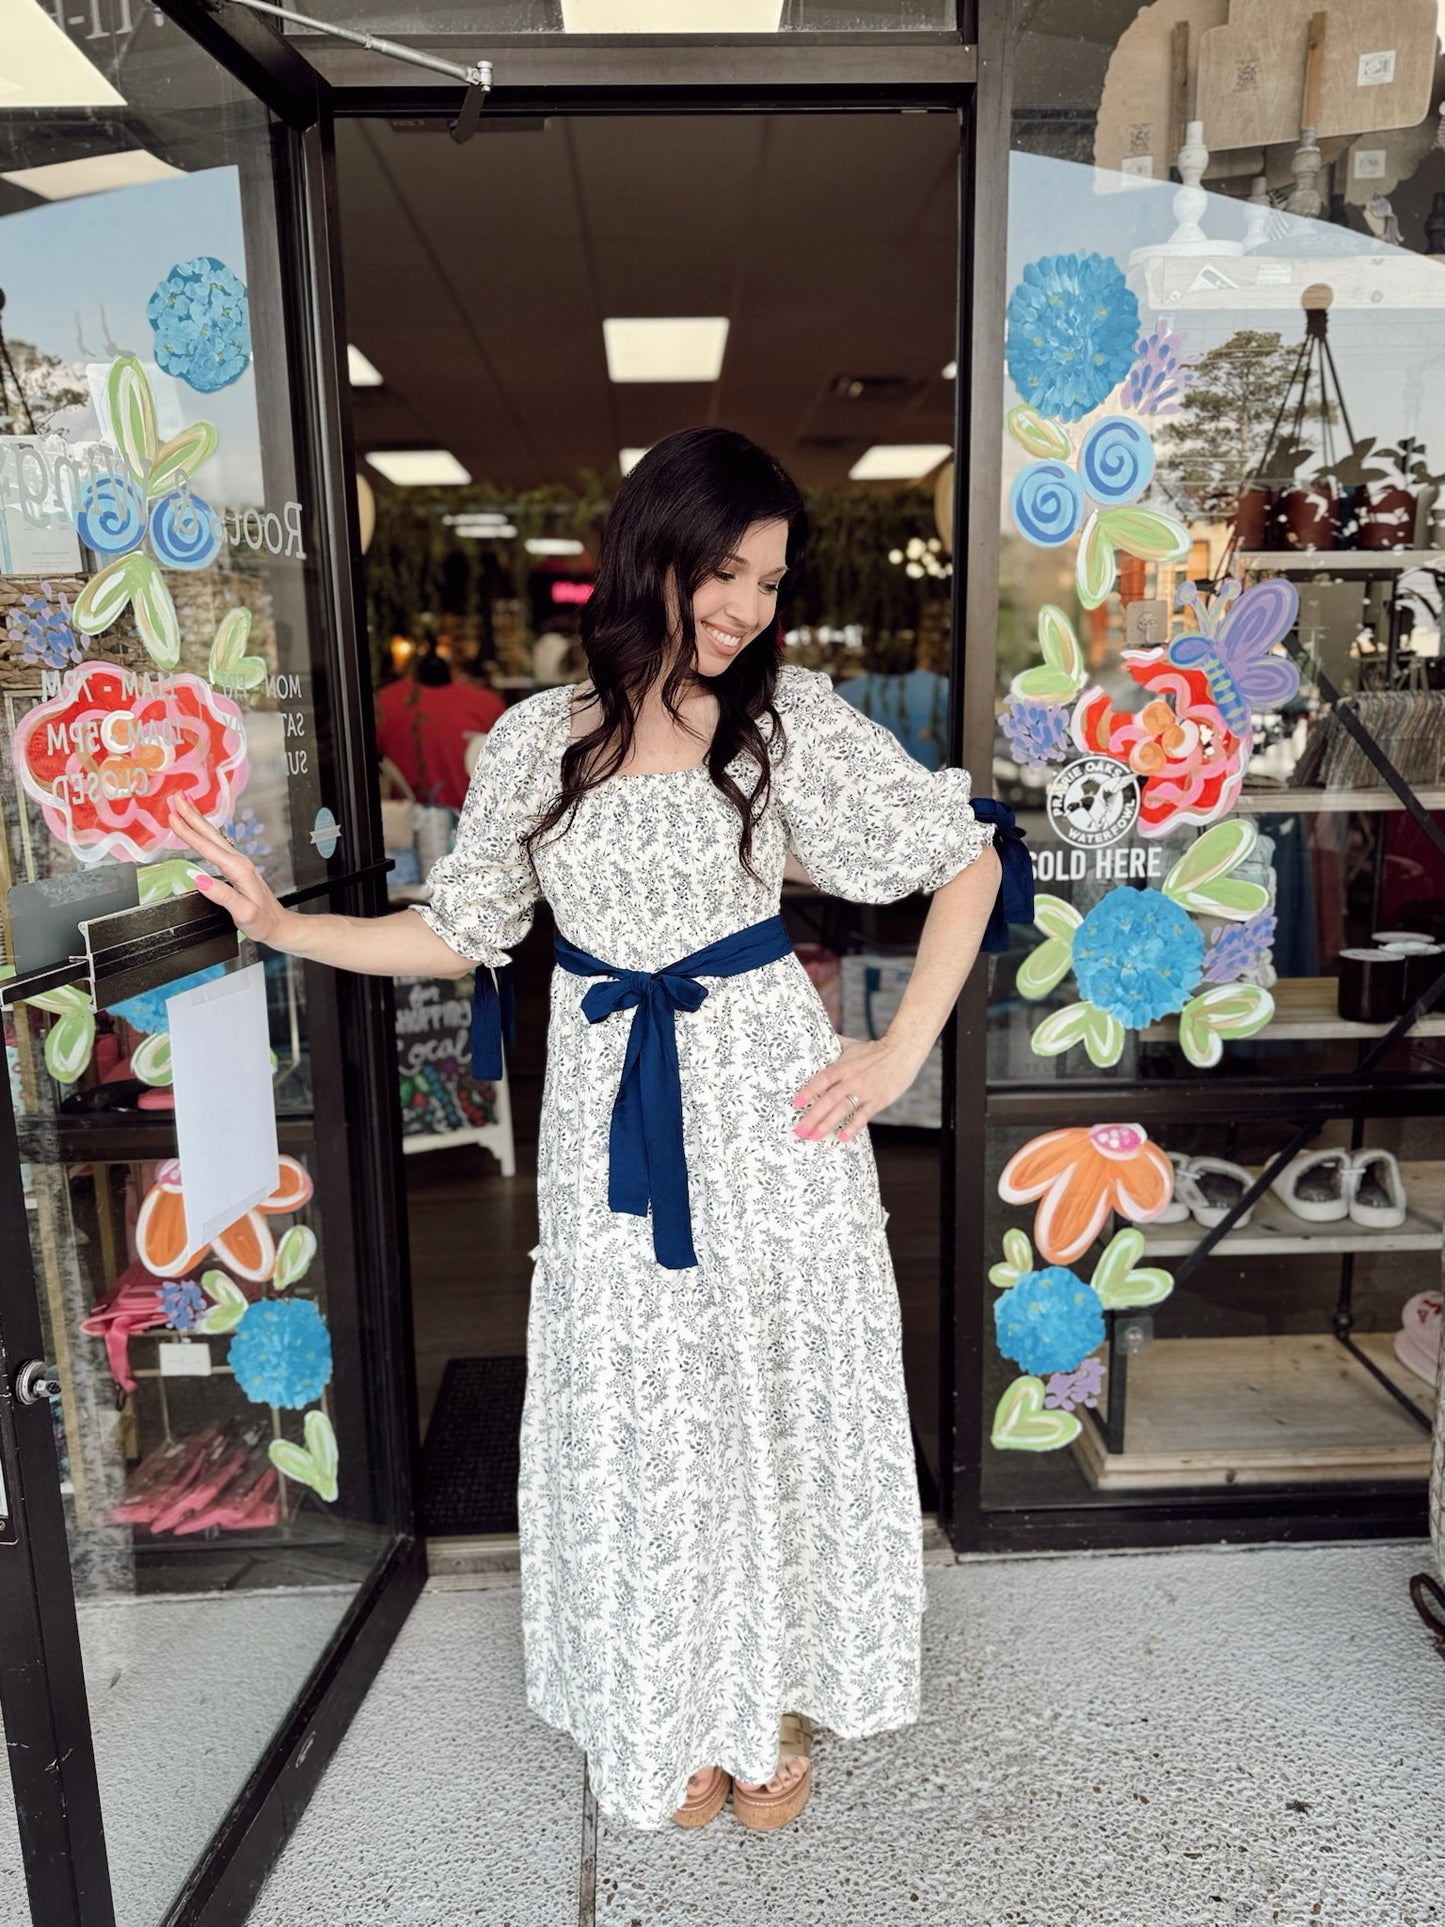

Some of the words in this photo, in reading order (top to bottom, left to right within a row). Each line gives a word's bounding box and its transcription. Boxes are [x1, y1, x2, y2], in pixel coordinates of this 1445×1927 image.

[1084, 760, 1123, 778] OAKS
[1068, 798, 1136, 844] WATERFOWL
[1095, 847, 1163, 880] HERE
